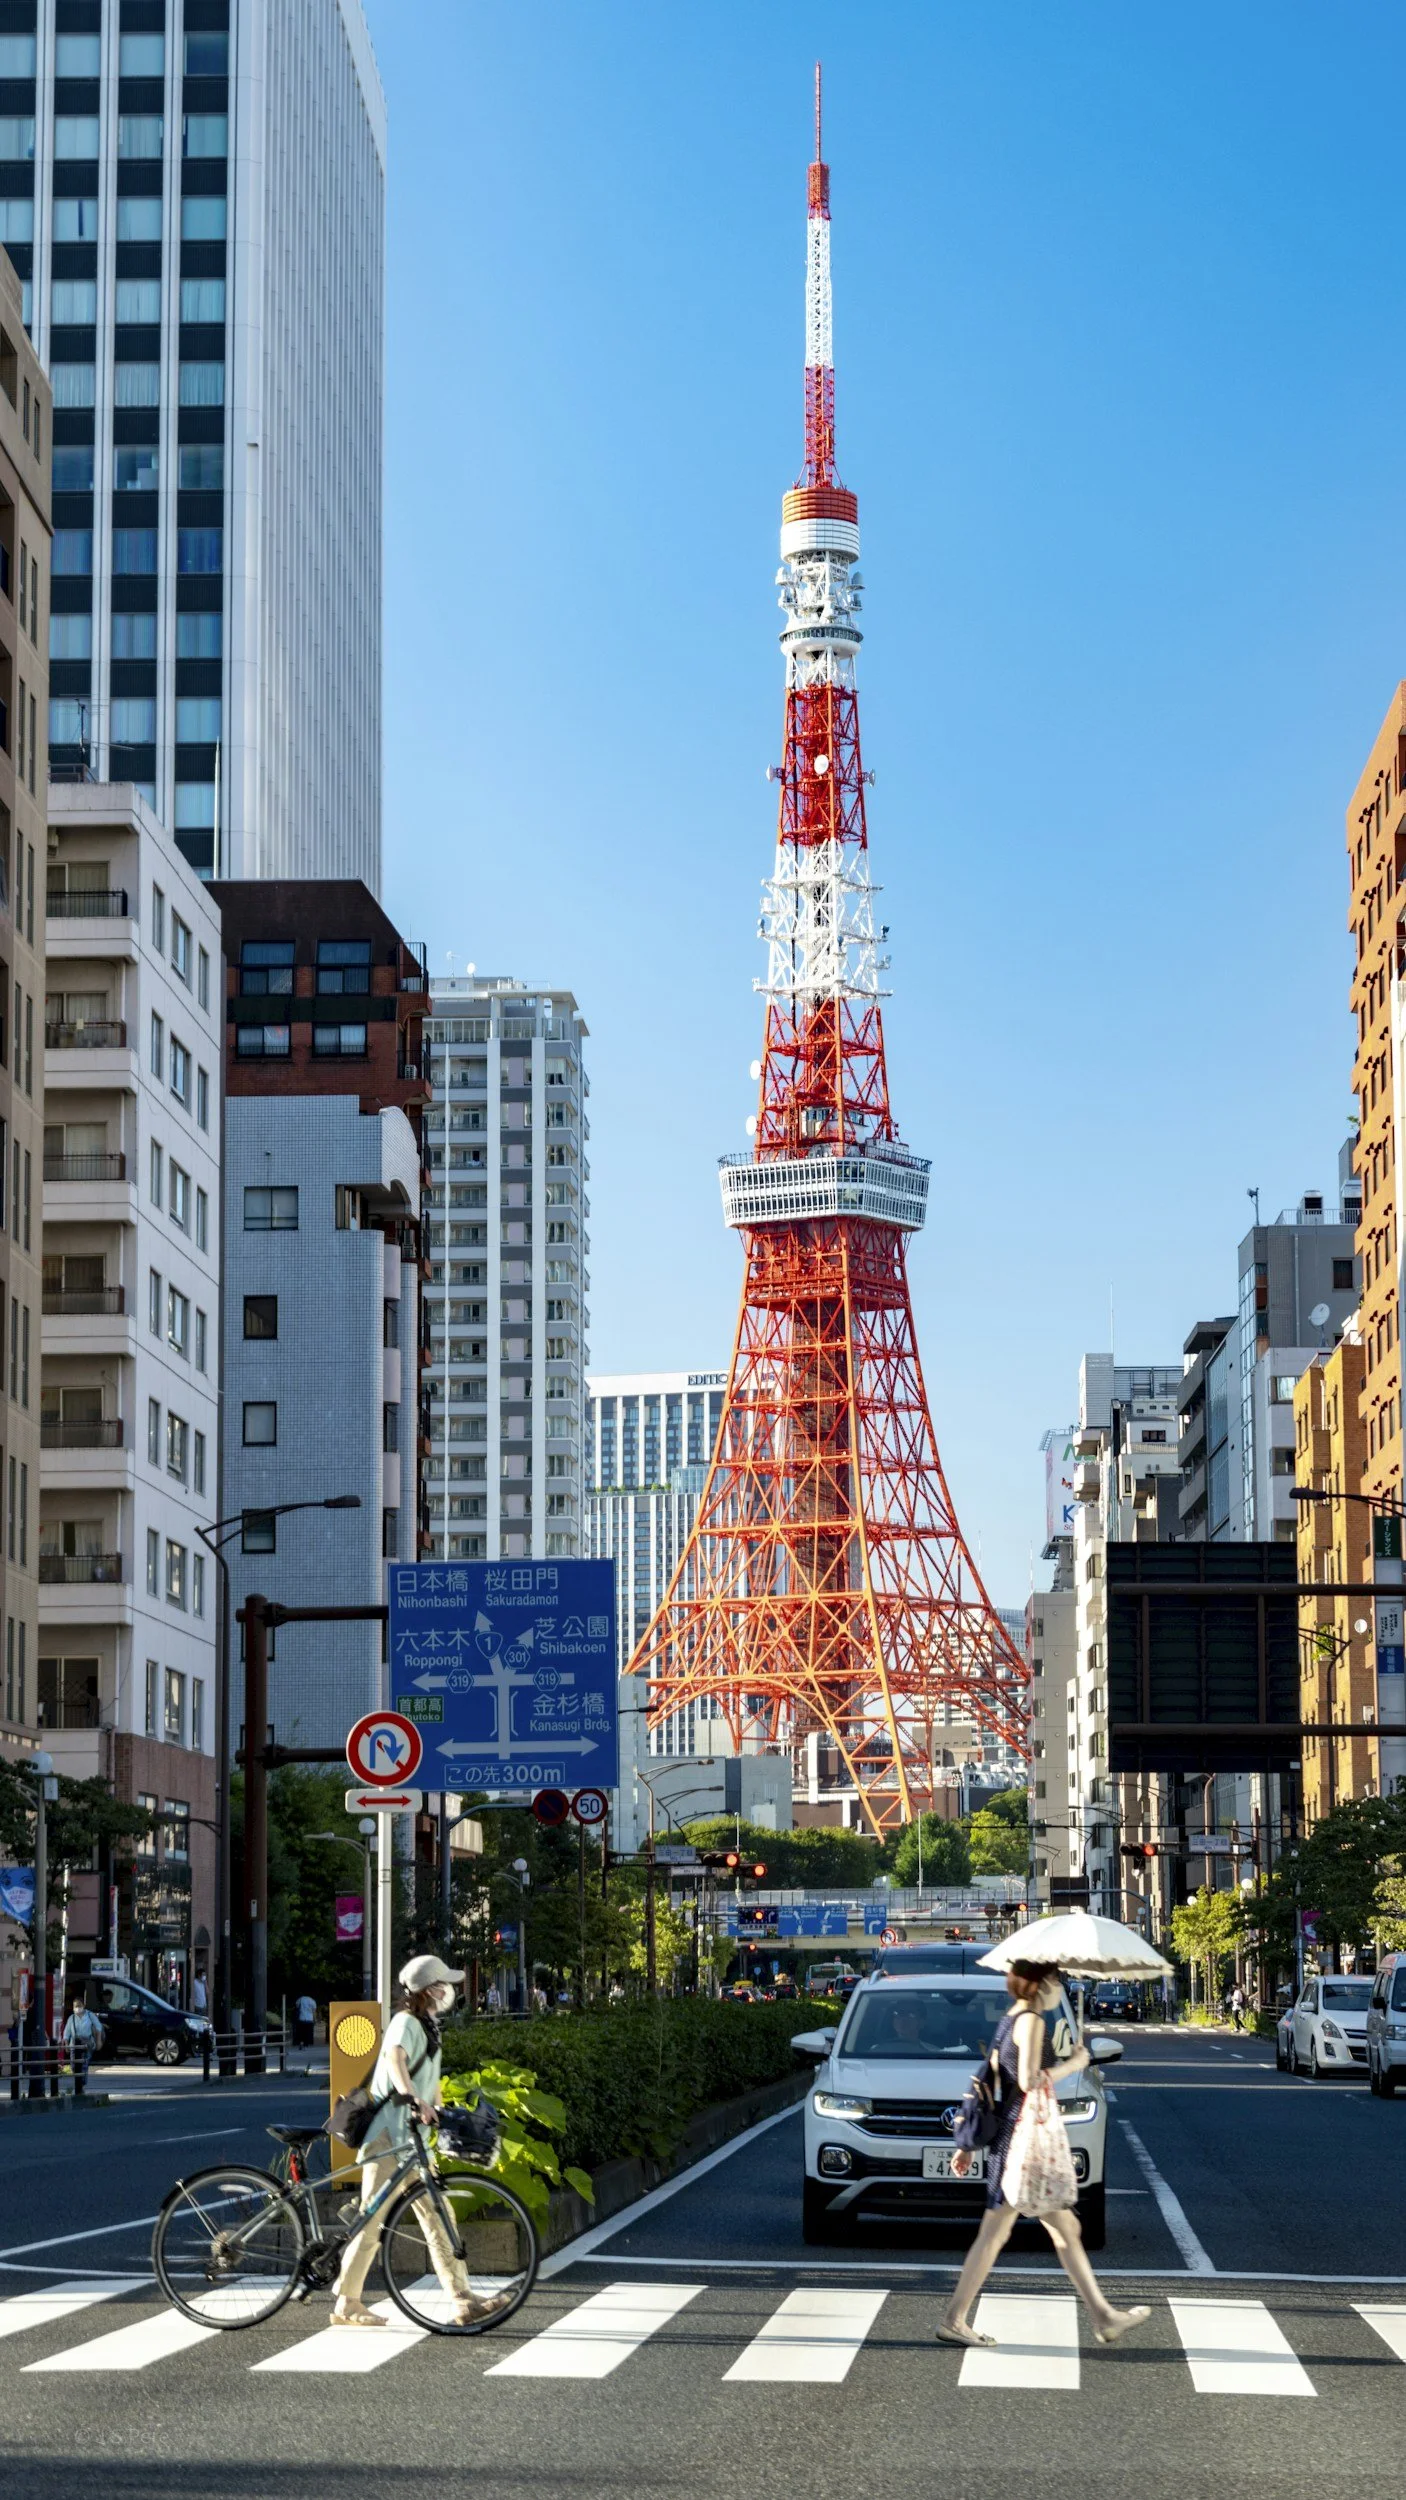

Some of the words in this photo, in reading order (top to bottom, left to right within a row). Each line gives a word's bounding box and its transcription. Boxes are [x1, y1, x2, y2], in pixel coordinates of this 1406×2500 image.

[688, 1373, 739, 1385] EDITIO
[397, 1570, 468, 1593] 日本橋
[484, 1568, 558, 1591] 桜田門
[398, 1594, 468, 1608] Nihonbashi
[486, 1593, 559, 1607] Sakuradamon
[535, 1615, 609, 1640] 芝公園
[396, 1628, 470, 1652] 六本木
[485, 1637, 491, 1650] 1
[540, 1642, 606, 1655] Shibakoen
[404, 1654, 463, 1669] Roppongi
[508, 1651, 526, 1663] 301
[451, 1674, 469, 1687] 319
[538, 1672, 556, 1685] 319
[399, 1698, 441, 1712] 首都高
[533, 1692, 605, 1716] 金杉橋
[530, 1719, 581, 1734] Kanasugi
[584, 1718, 612, 1733] Brdg.
[580, 1799, 600, 1814] 50
